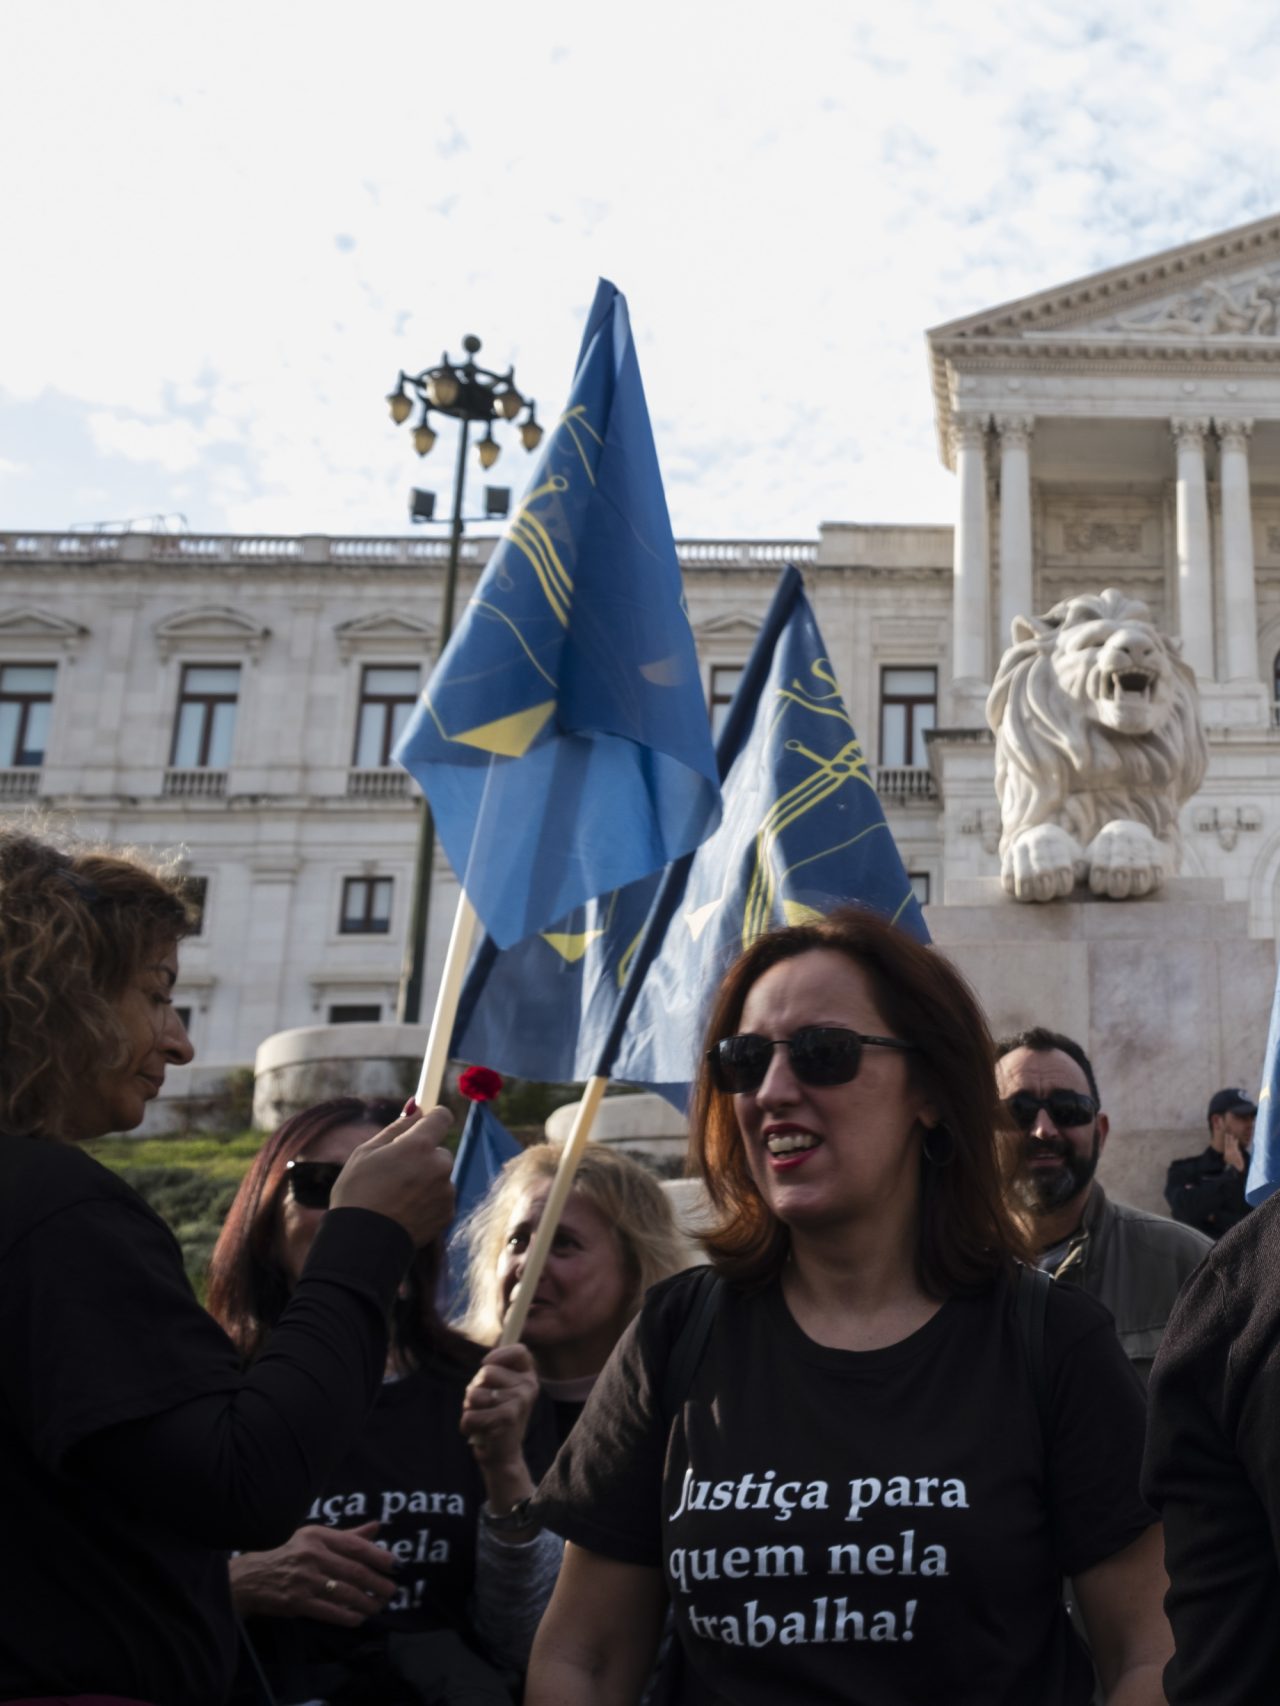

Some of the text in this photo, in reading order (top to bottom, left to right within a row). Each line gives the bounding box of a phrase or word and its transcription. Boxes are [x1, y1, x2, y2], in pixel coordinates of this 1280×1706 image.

[380, 1490, 465, 1525] para
[669, 1467, 969, 1522] Justiça para
[669, 1529, 950, 1593] quem nela
[689, 1596, 918, 1648] trabalha!
